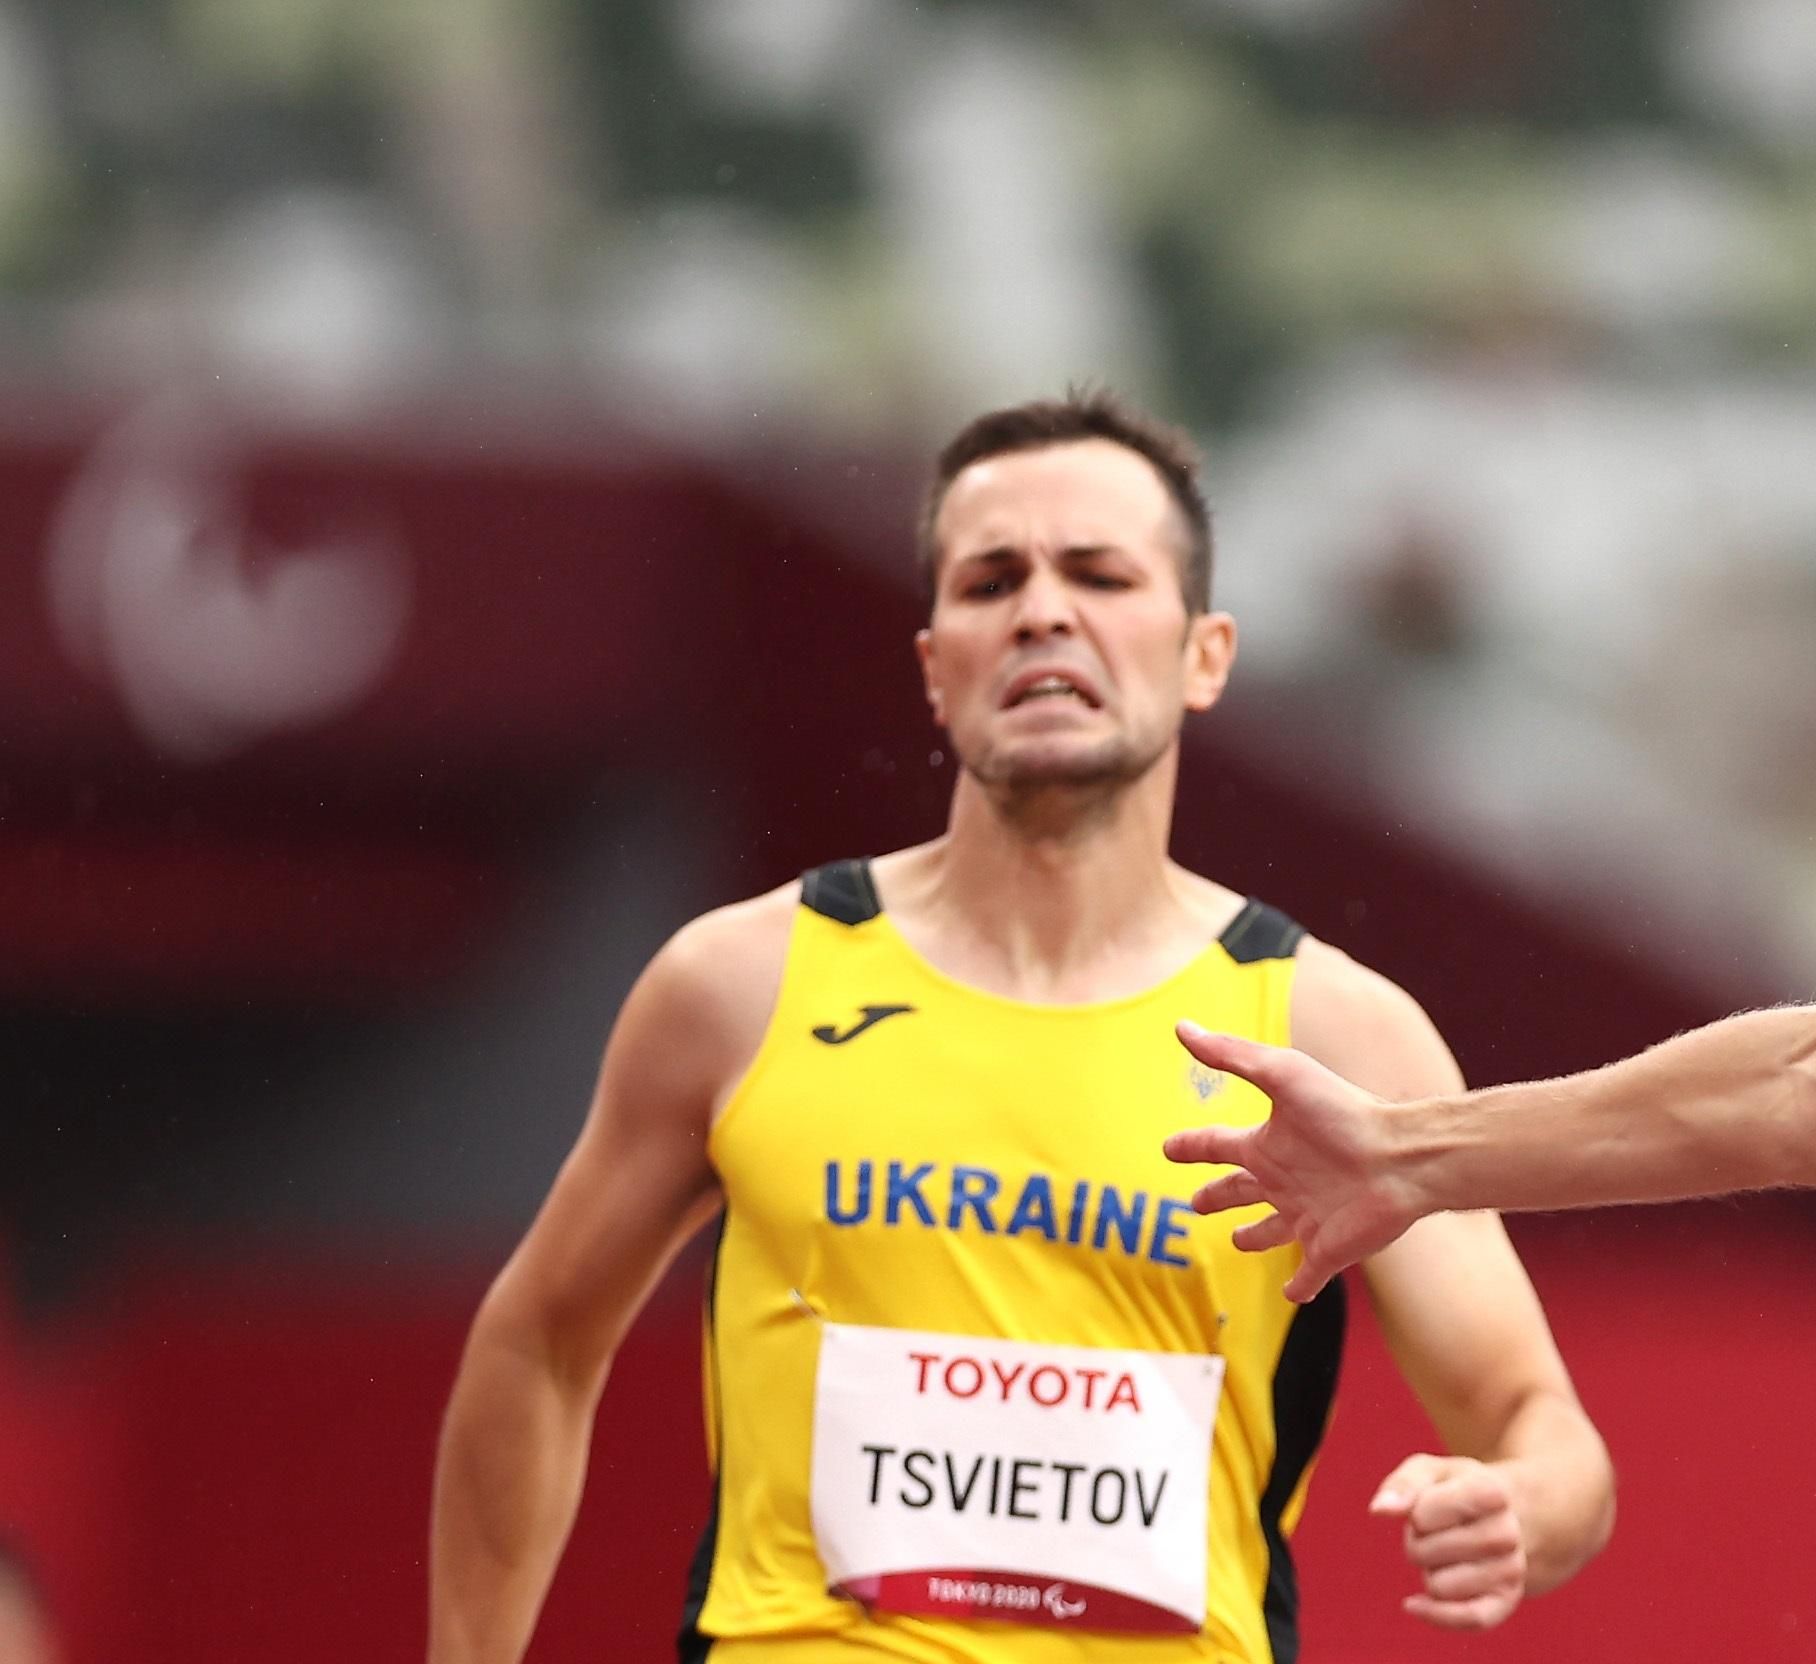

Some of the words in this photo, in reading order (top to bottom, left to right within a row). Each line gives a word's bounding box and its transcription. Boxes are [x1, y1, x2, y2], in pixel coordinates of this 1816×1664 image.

[825, 1159, 1197, 1269] UKRAINE
[908, 1352, 1144, 1414] TOYOTA
[861, 1444, 1170, 1529] TSVIETOV
